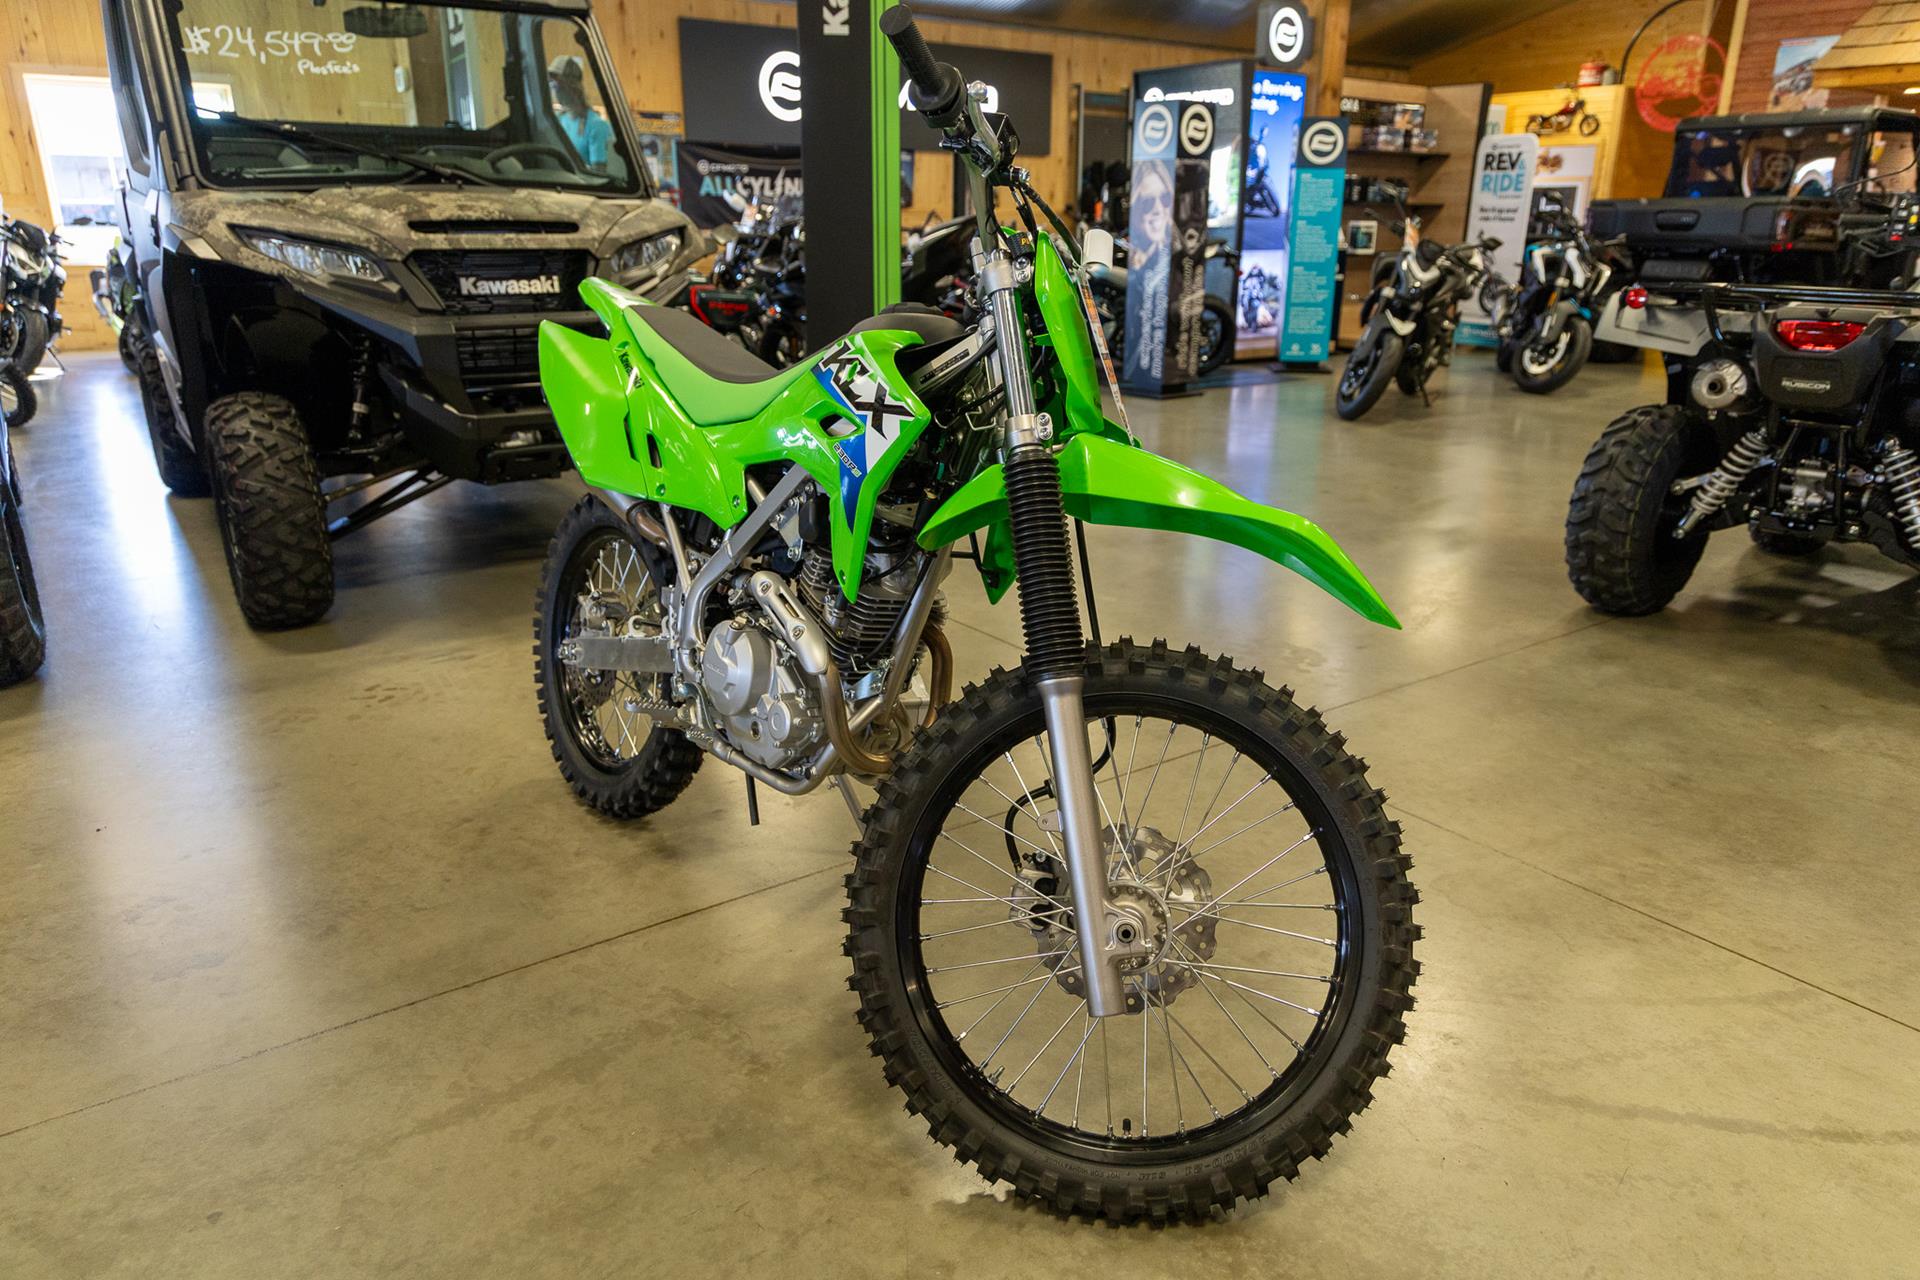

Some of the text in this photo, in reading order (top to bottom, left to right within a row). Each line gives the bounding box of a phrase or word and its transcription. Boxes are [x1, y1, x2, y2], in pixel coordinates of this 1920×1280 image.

[1484, 151, 1522, 171] REV
[1481, 174, 1524, 196] RIDE
[459, 275, 561, 295] Kawasaki
[821, 341, 915, 441] KLX
